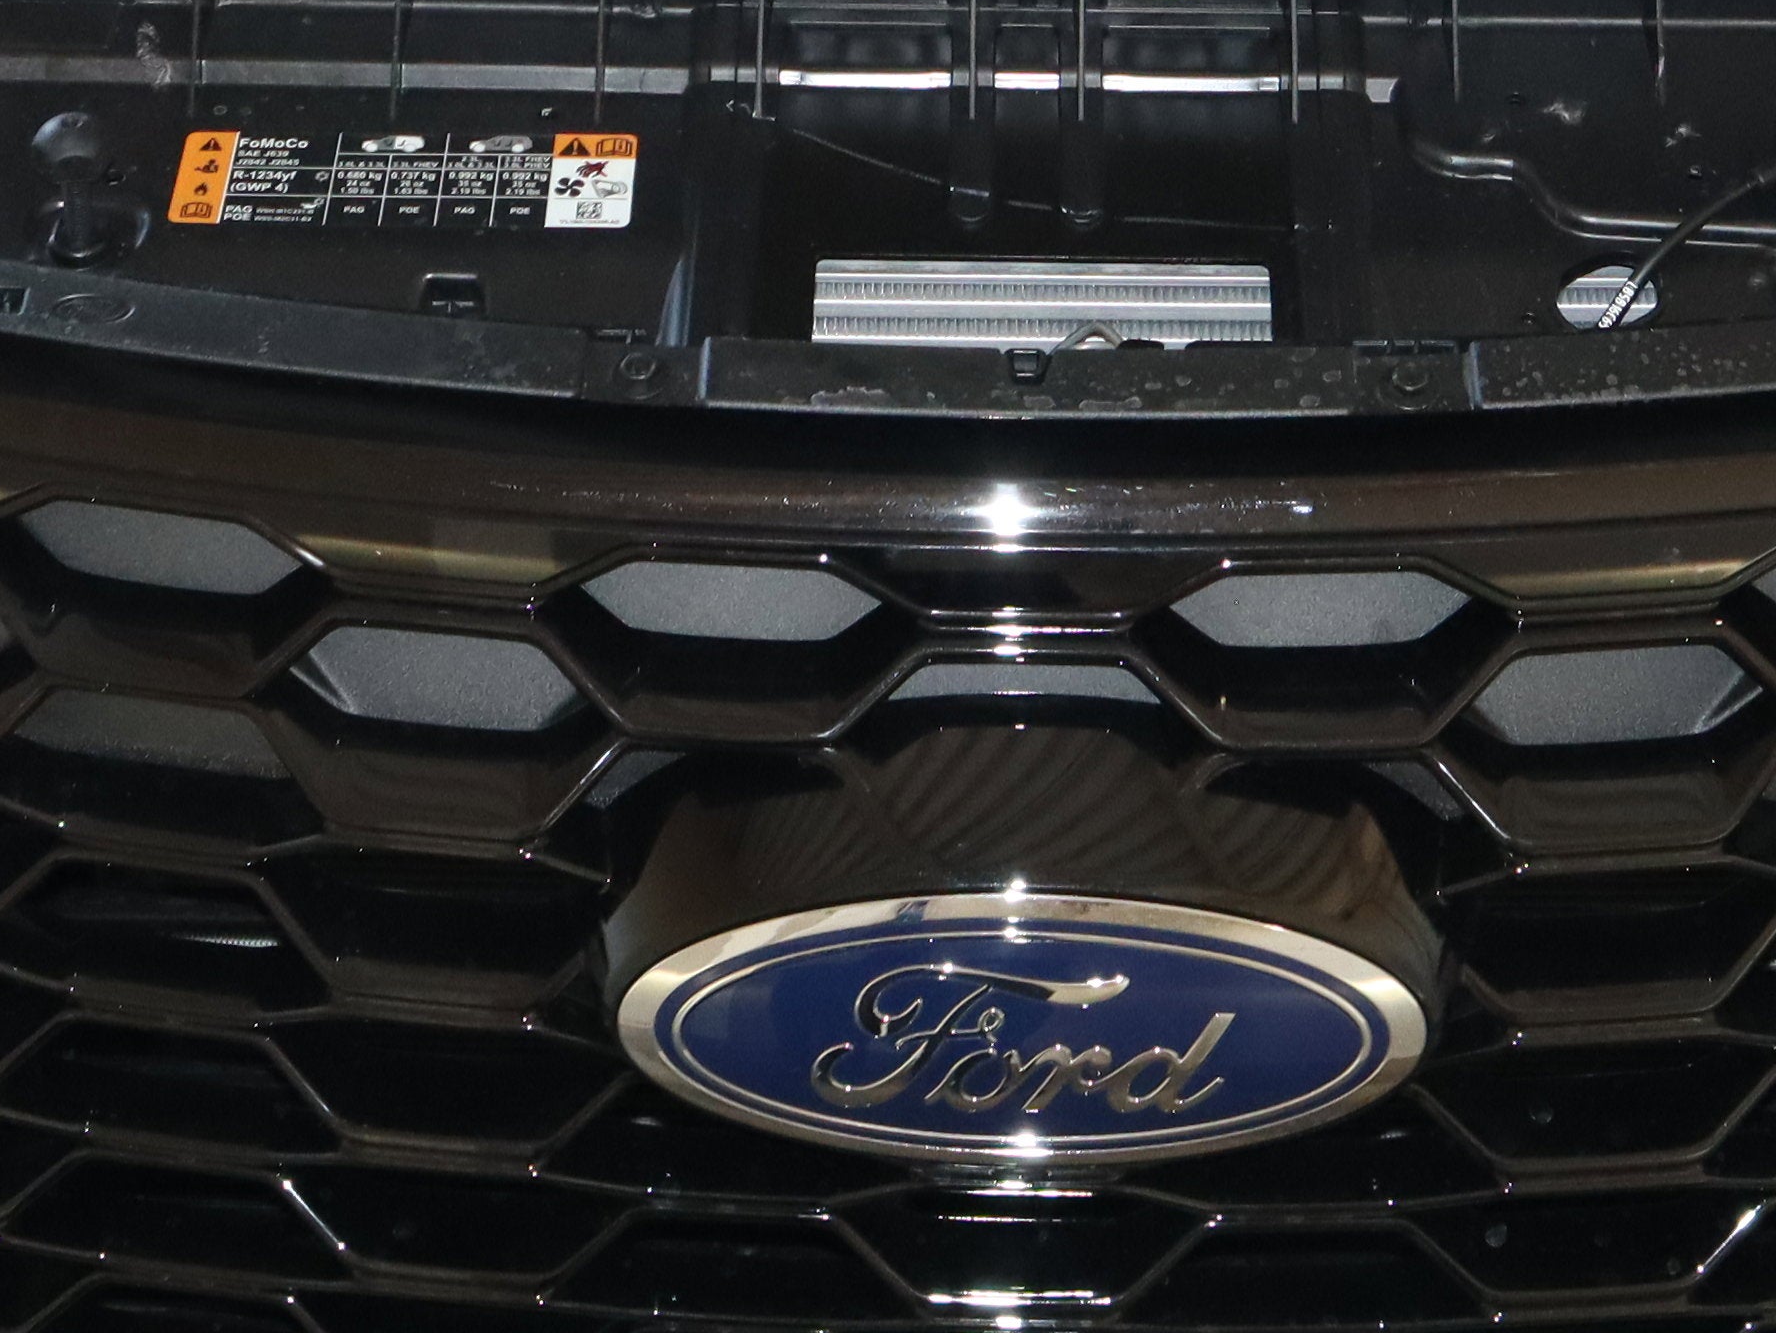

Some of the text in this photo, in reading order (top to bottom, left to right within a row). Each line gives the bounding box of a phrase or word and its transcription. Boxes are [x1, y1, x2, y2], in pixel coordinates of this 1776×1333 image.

[239, 137, 309, 149] FoMoCo
[232, 170, 298, 182] R-1234yf
[368, 171, 383, 181] kg
[390, 171, 436, 181] 0.737 kg
[479, 172, 494, 181] kg
[533, 172, 549, 182] kg
[230, 182, 289, 193] (GWP 4)
[225, 205, 253, 213] PAG
[453, 206, 476, 214] PAG
[509, 206, 531, 214] POE
[224, 213, 251, 221] POE
[811, 963, 1236, 1114] Ford
